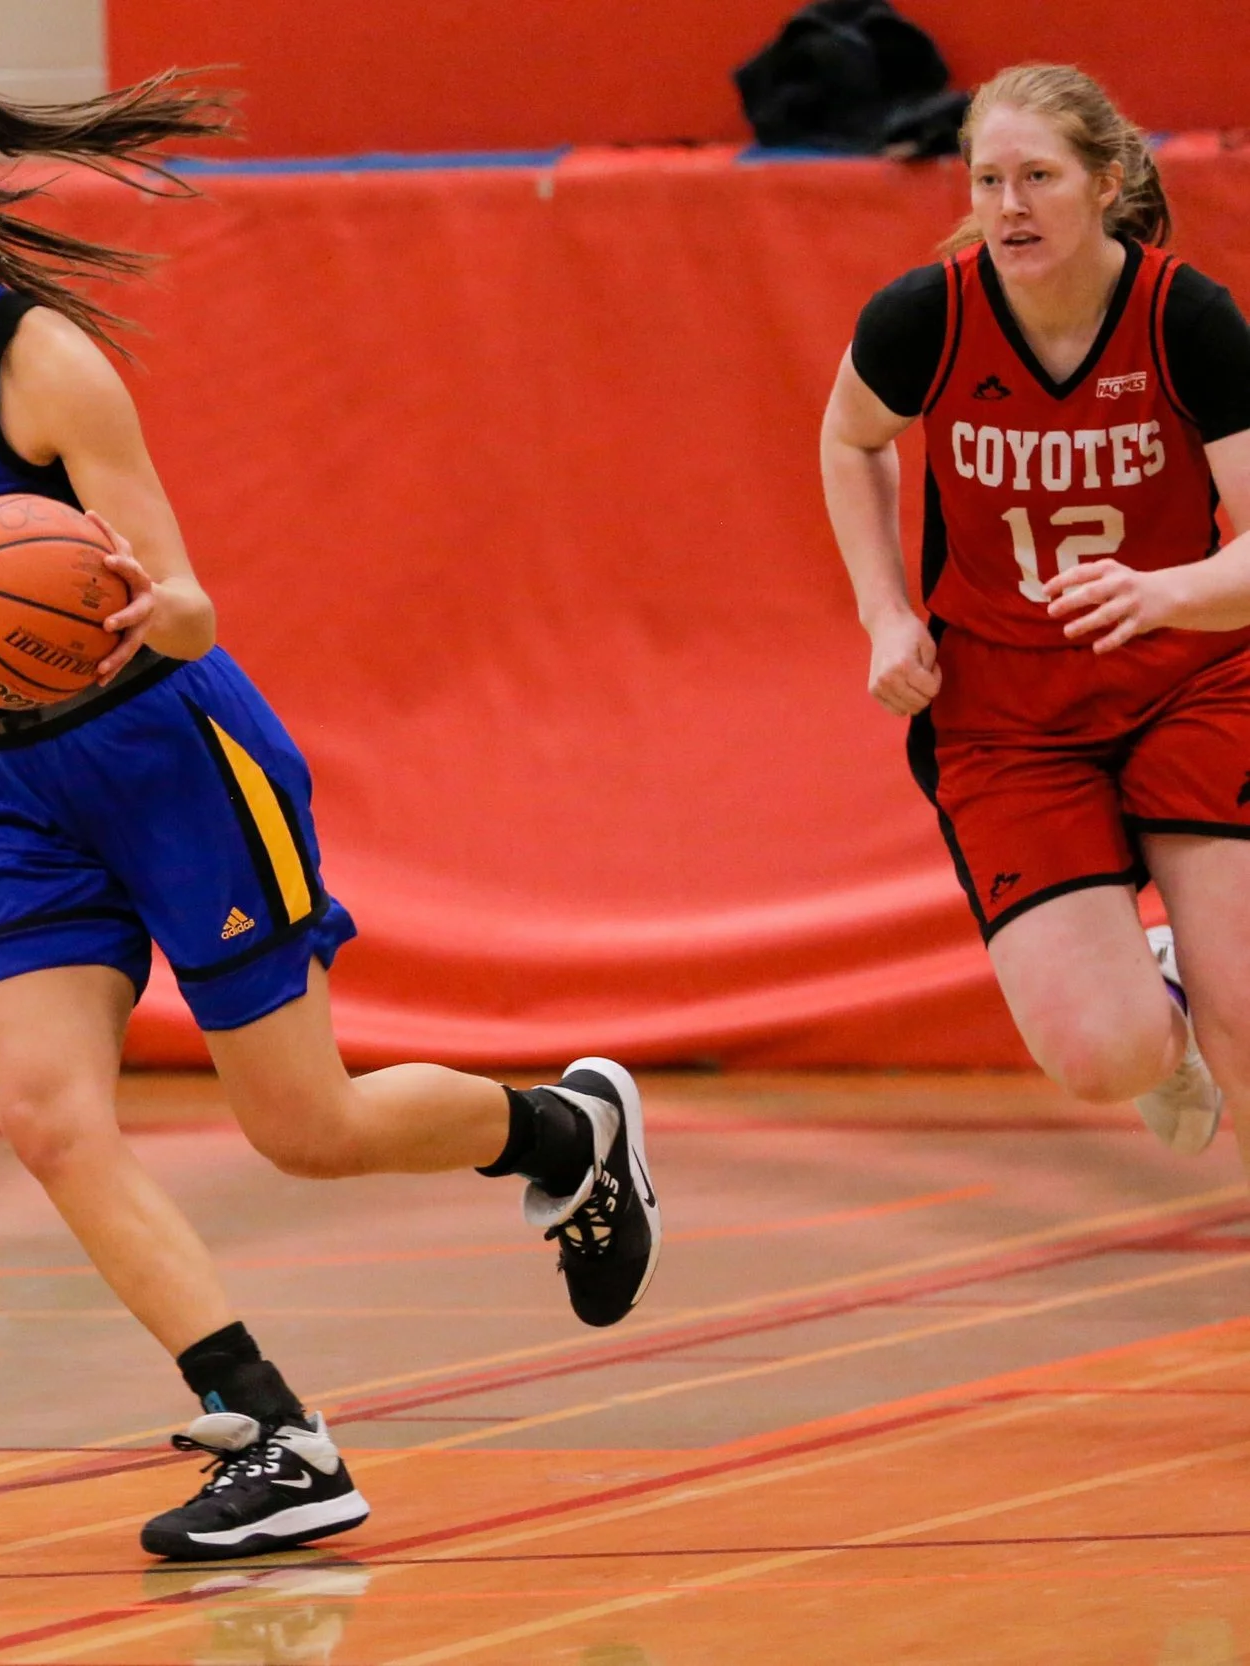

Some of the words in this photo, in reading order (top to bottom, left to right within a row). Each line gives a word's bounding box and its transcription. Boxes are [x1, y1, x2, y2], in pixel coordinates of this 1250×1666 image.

[951, 420, 1165, 491] COYOTES
[1001, 504, 1125, 603] 12
[221, 918, 255, 940] adidas
